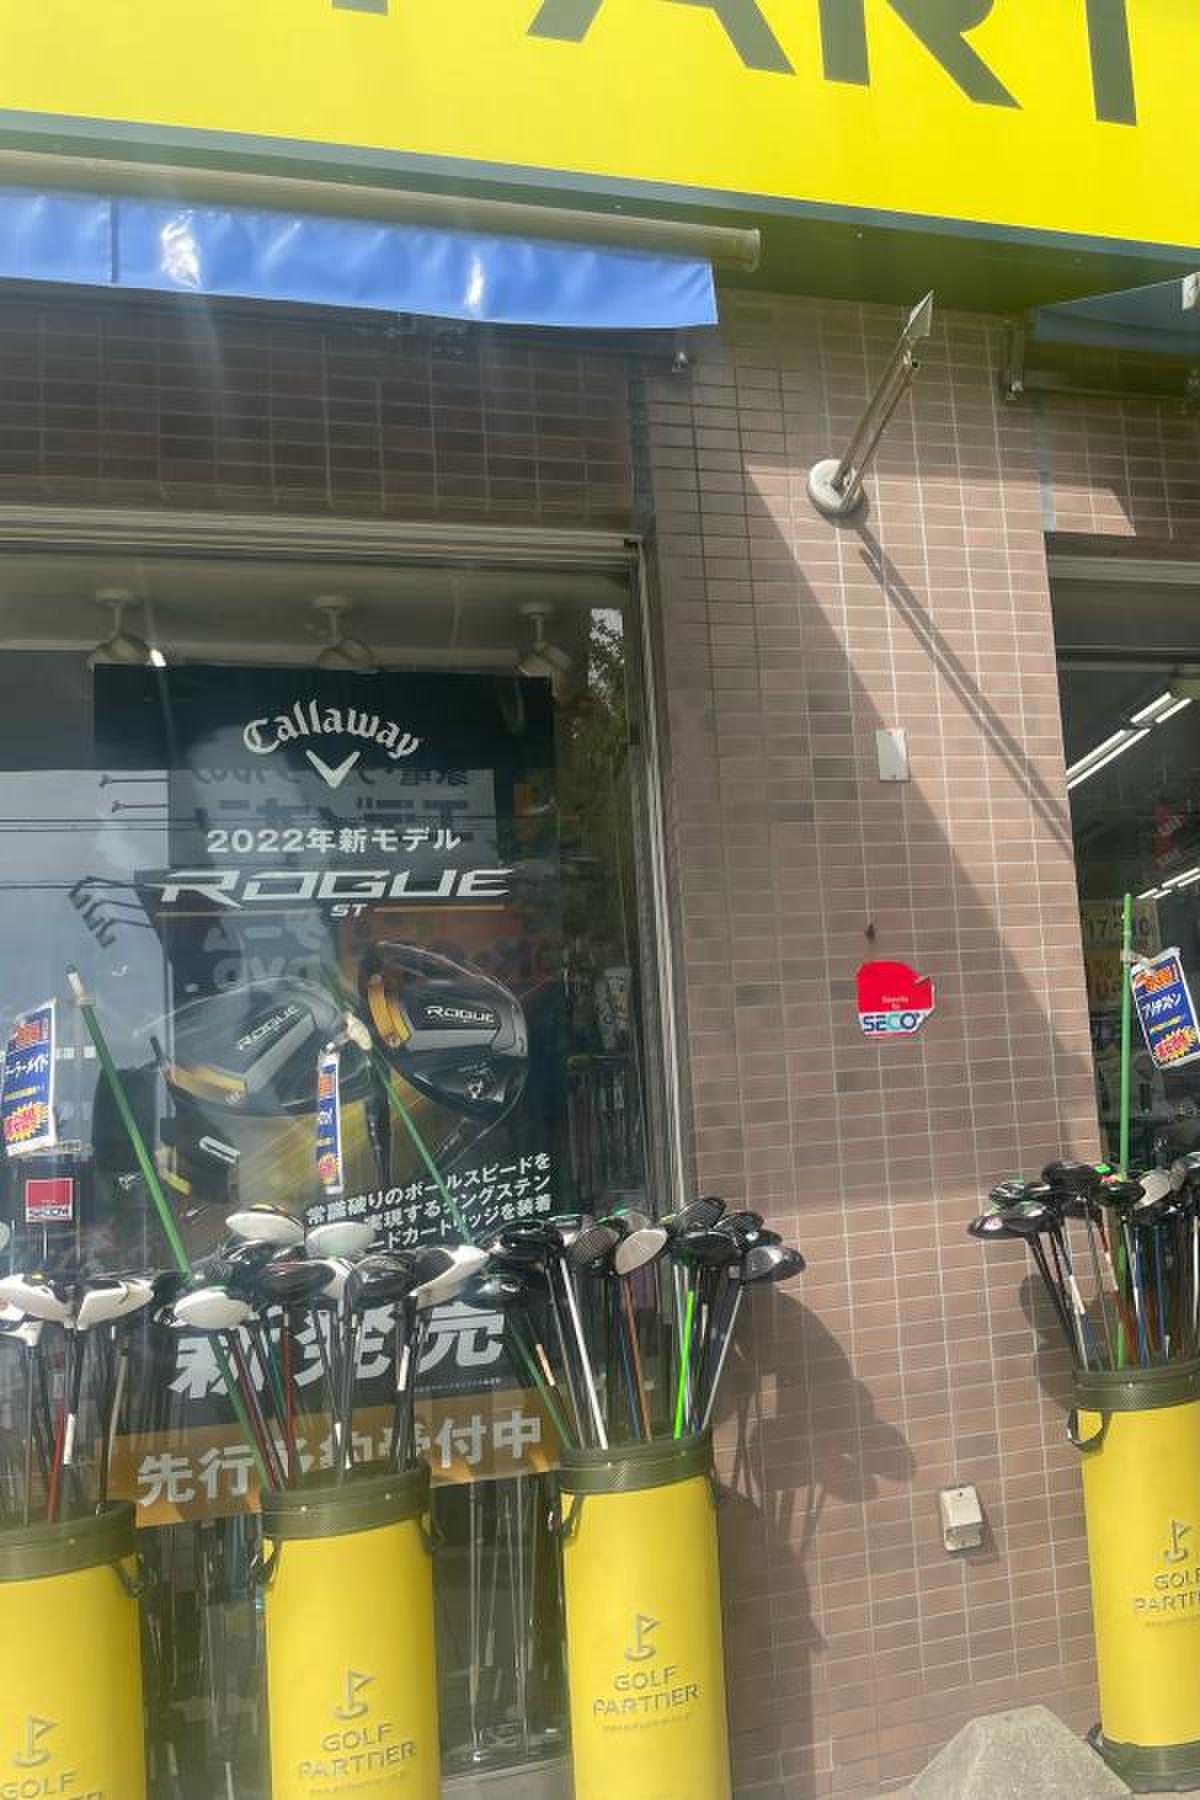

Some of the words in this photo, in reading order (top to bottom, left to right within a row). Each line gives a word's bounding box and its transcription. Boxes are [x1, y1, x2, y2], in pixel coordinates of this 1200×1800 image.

[243, 699, 420, 759] Callaway
[207, 828, 462, 853] 2022年新モデル
[145, 869, 513, 908] ROGUE
[330, 903, 368, 917] ST
[423, 1004, 496, 1024] ROGUE
[863, 1012, 920, 1032] SECO
[613, 1666, 678, 1692] GOLF
[593, 1682, 703, 1718] PARTNER
[321, 1722, 395, 1752] GOLF
[297, 1741, 418, 1779] PARTNER
[0, 1770, 76, 1800] GOLF
